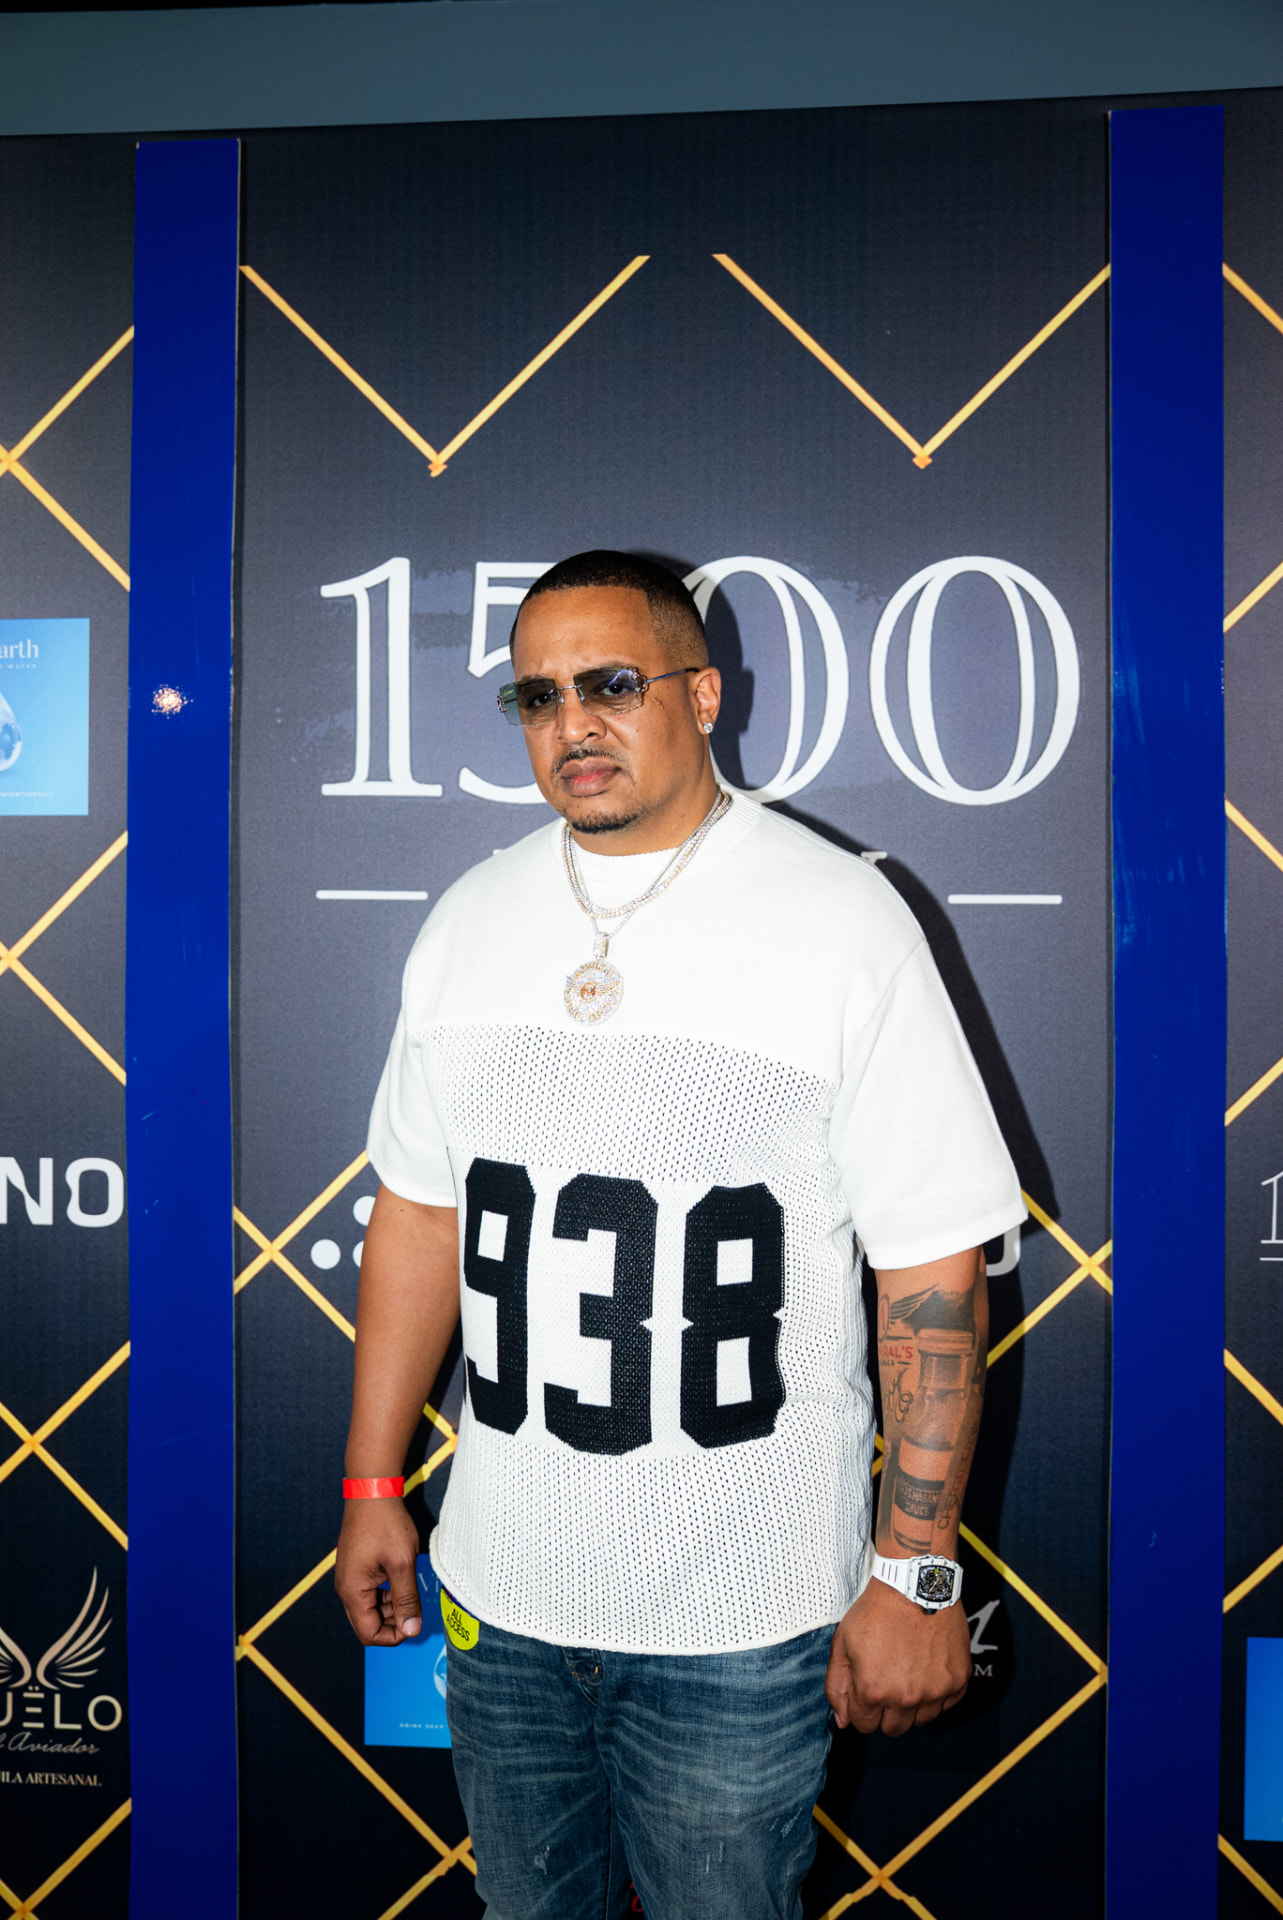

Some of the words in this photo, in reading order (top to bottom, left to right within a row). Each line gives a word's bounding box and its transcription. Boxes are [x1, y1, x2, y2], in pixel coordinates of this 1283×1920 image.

[0, 1156, 125, 1228] NO
[463, 1157, 786, 1457] 938
[446, 1613, 471, 1642] ACCESS
[451, 1608, 463, 1625] ALL
[7, 1731, 100, 1755] Aviador
[25, 1772, 103, 1787] ARTESANAL
